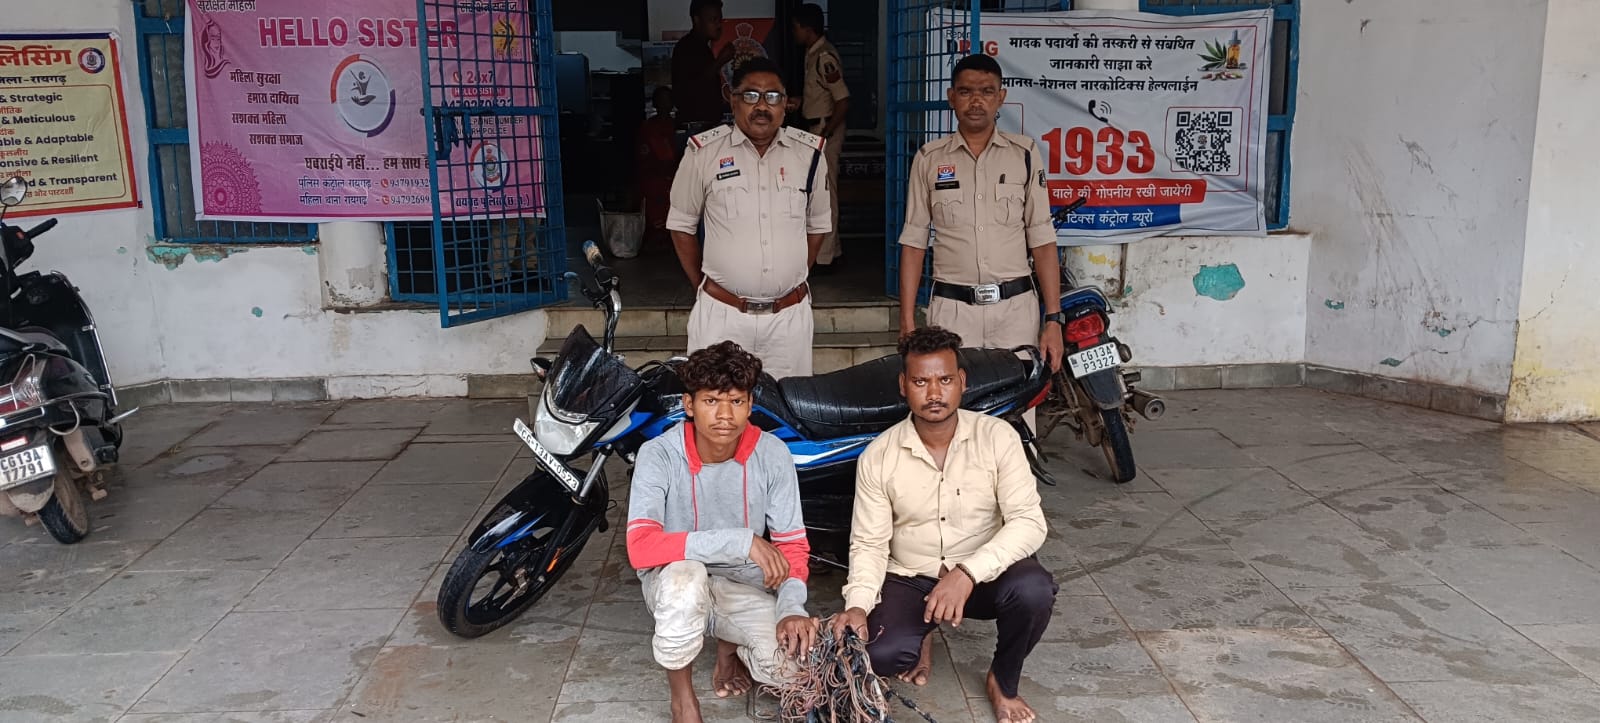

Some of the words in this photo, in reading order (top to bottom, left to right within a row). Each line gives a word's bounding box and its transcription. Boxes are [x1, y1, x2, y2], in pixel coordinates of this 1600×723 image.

[259, 18, 348, 47] HELLO
[358, 19, 458, 48] SISTER
[1009, 37, 1041, 48] मादक
[1083, 33, 1099, 48] की
[1102, 34, 1138, 49] तस्करी
[1141, 35, 1151, 49] से
[0, 45, 72, 66] लिसिंग
[947, 39, 999, 56] DRG
[1050, 55, 1099, 69] जानकारी
[1104, 59, 1133, 70] साझा
[1136, 55, 1152, 70] करे
[230, 69, 253, 83] महिला
[256, 72, 281, 87] सुरक्षा
[1001, 75, 1077, 90] मानस-नेशनल
[1081, 76, 1145, 91] नारकोटिक्स
[1148, 76, 1199, 92] हेल्पलाईन
[10, 93, 63, 105] Strategic
[247, 92, 268, 104] हमारा
[270, 91, 299, 105] दायित्व
[1, 116, 10, 125] &
[13, 114, 76, 125] Meticulous
[232, 113, 259, 124] सशक्त
[262, 111, 287, 124] महिला
[24, 136, 32, 145] &
[36, 133, 94, 147] Adaptable
[249, 133, 276, 145] सशक्त
[279, 134, 304, 145] समाज
[1041, 126, 1156, 175] 1933
[40, 156, 49, 165] &
[51, 154, 99, 165] Resilient
[304, 153, 344, 172] घबराईये
[383, 157, 398, 170] हम
[401, 157, 421, 170] साथ
[38, 177, 47, 186] &
[49, 173, 117, 187] Transparent
[299, 176, 320, 189] पुलिस
[348, 178, 372, 189] रायगढ़
[390, 178, 430, 187] 94791932
[1053, 185, 1073, 199] वाले
[1077, 186, 1091, 198] की
[1096, 184, 1131, 198] गोपनीय
[1136, 184, 1156, 198] रखी
[1160, 183, 1192, 197] जायेगी
[300, 193, 322, 205] महिला
[325, 195, 341, 205] थाना
[344, 195, 368, 206] रायगढ़
[391, 196, 431, 205] 94792699
[1099, 210, 1129, 226] कंट्रोल
[1080, 346, 1112, 363] CG13A
[1083, 355, 1116, 373] P3322
[0, 448, 42, 470] CG13A
